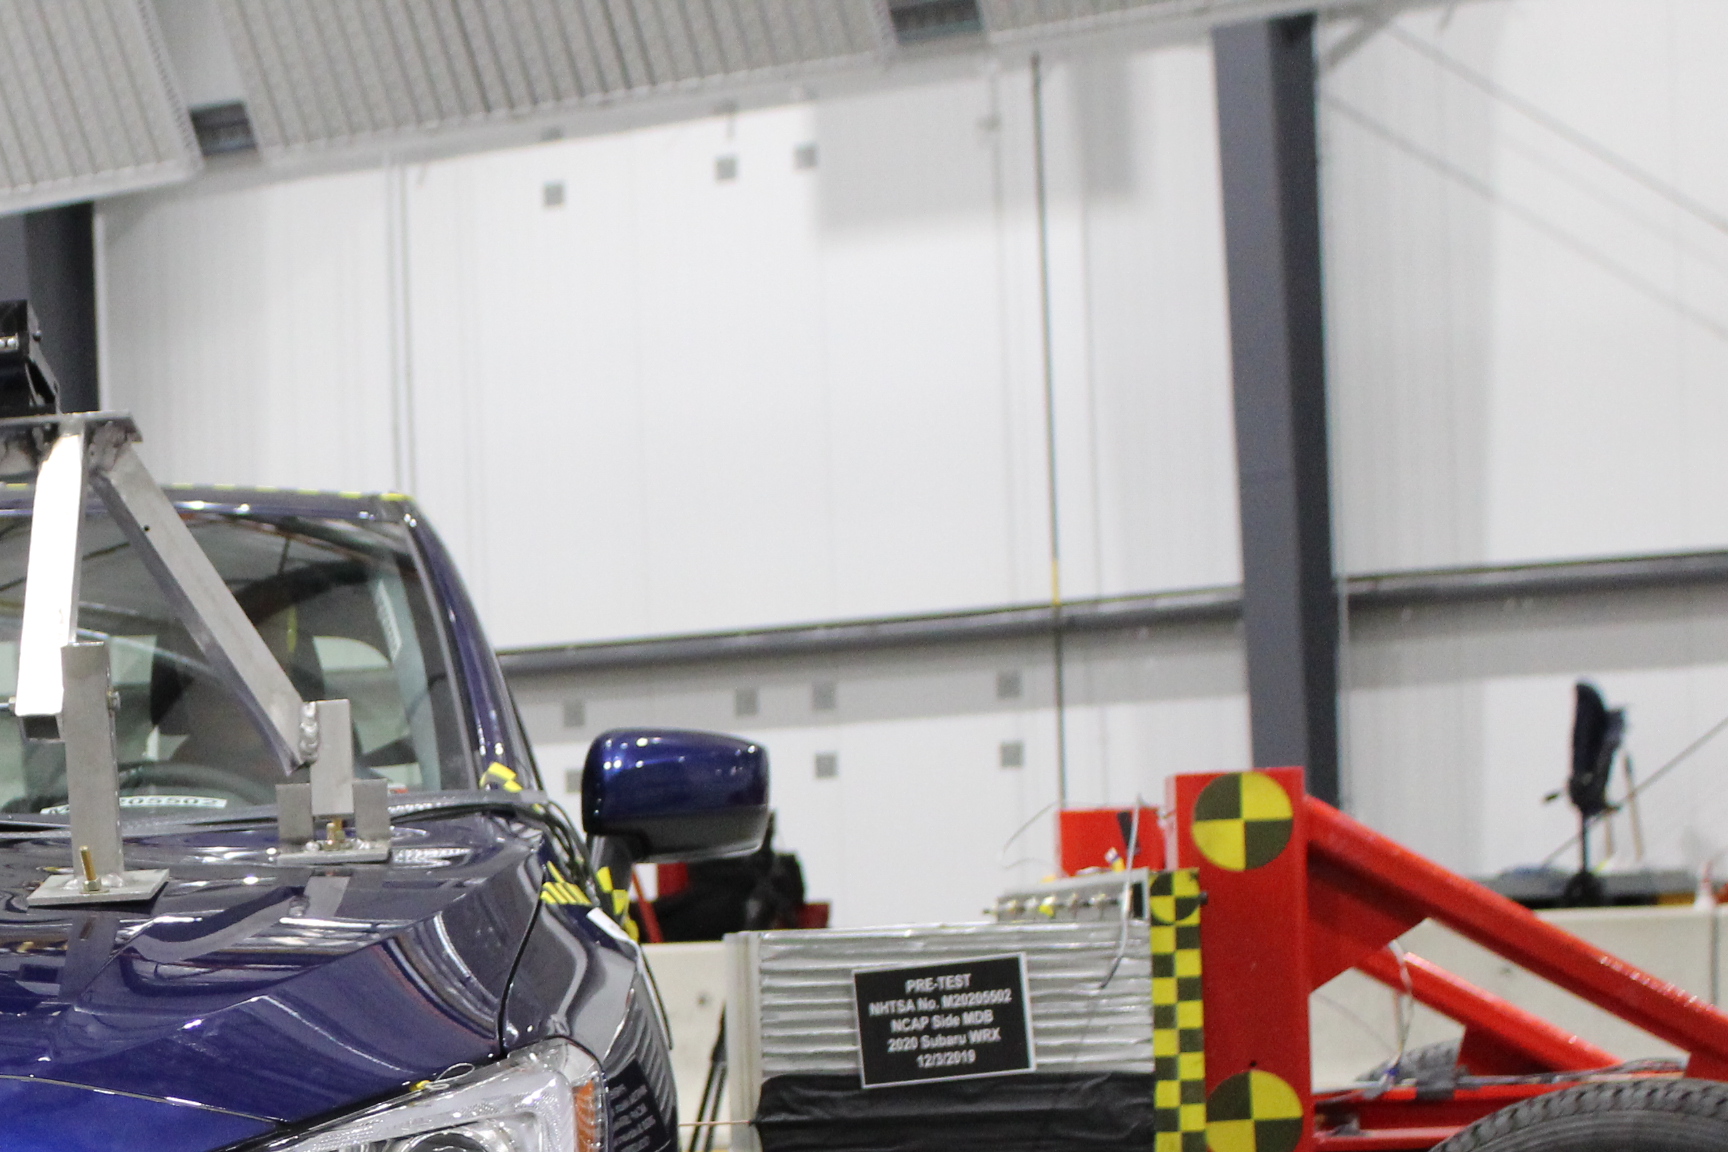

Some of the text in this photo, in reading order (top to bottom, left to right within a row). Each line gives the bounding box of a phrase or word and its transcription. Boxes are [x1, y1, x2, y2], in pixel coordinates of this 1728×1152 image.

[905, 973, 972, 993] PRE-TEST
[869, 988, 1013, 1016] NHTSA No. M20205502
[890, 1009, 994, 1033] NCAP Side MDB
[887, 1027, 1002, 1053] 2020 Subaru WRX
[917, 1049, 976, 1069] 12/3/2019
